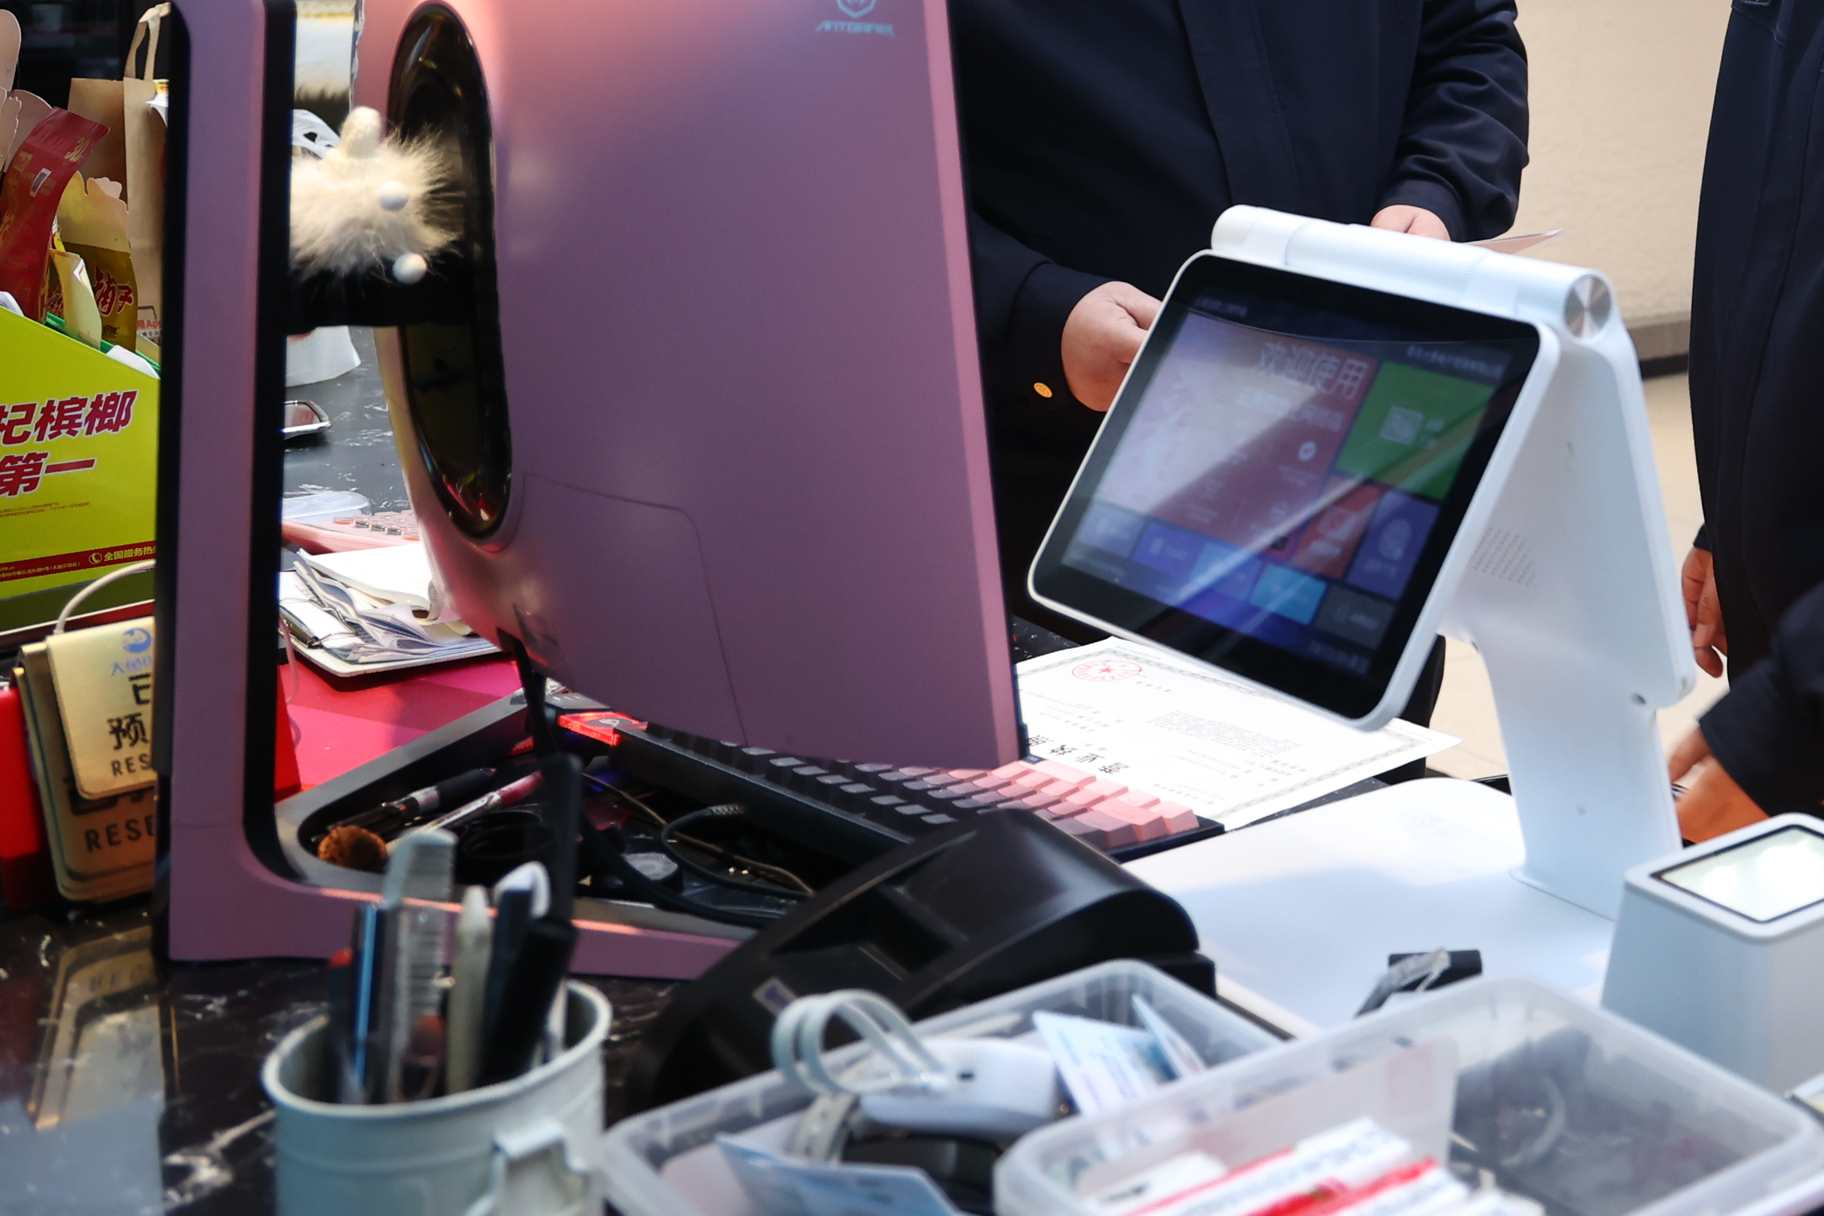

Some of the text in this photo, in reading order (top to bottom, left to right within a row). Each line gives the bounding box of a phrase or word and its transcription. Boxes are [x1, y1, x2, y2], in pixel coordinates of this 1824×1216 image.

[1253, 338, 1369, 401] 欢迎使用
[0, 451, 96, 497] 第一
[103, 545, 156, 562] 全国服务热
